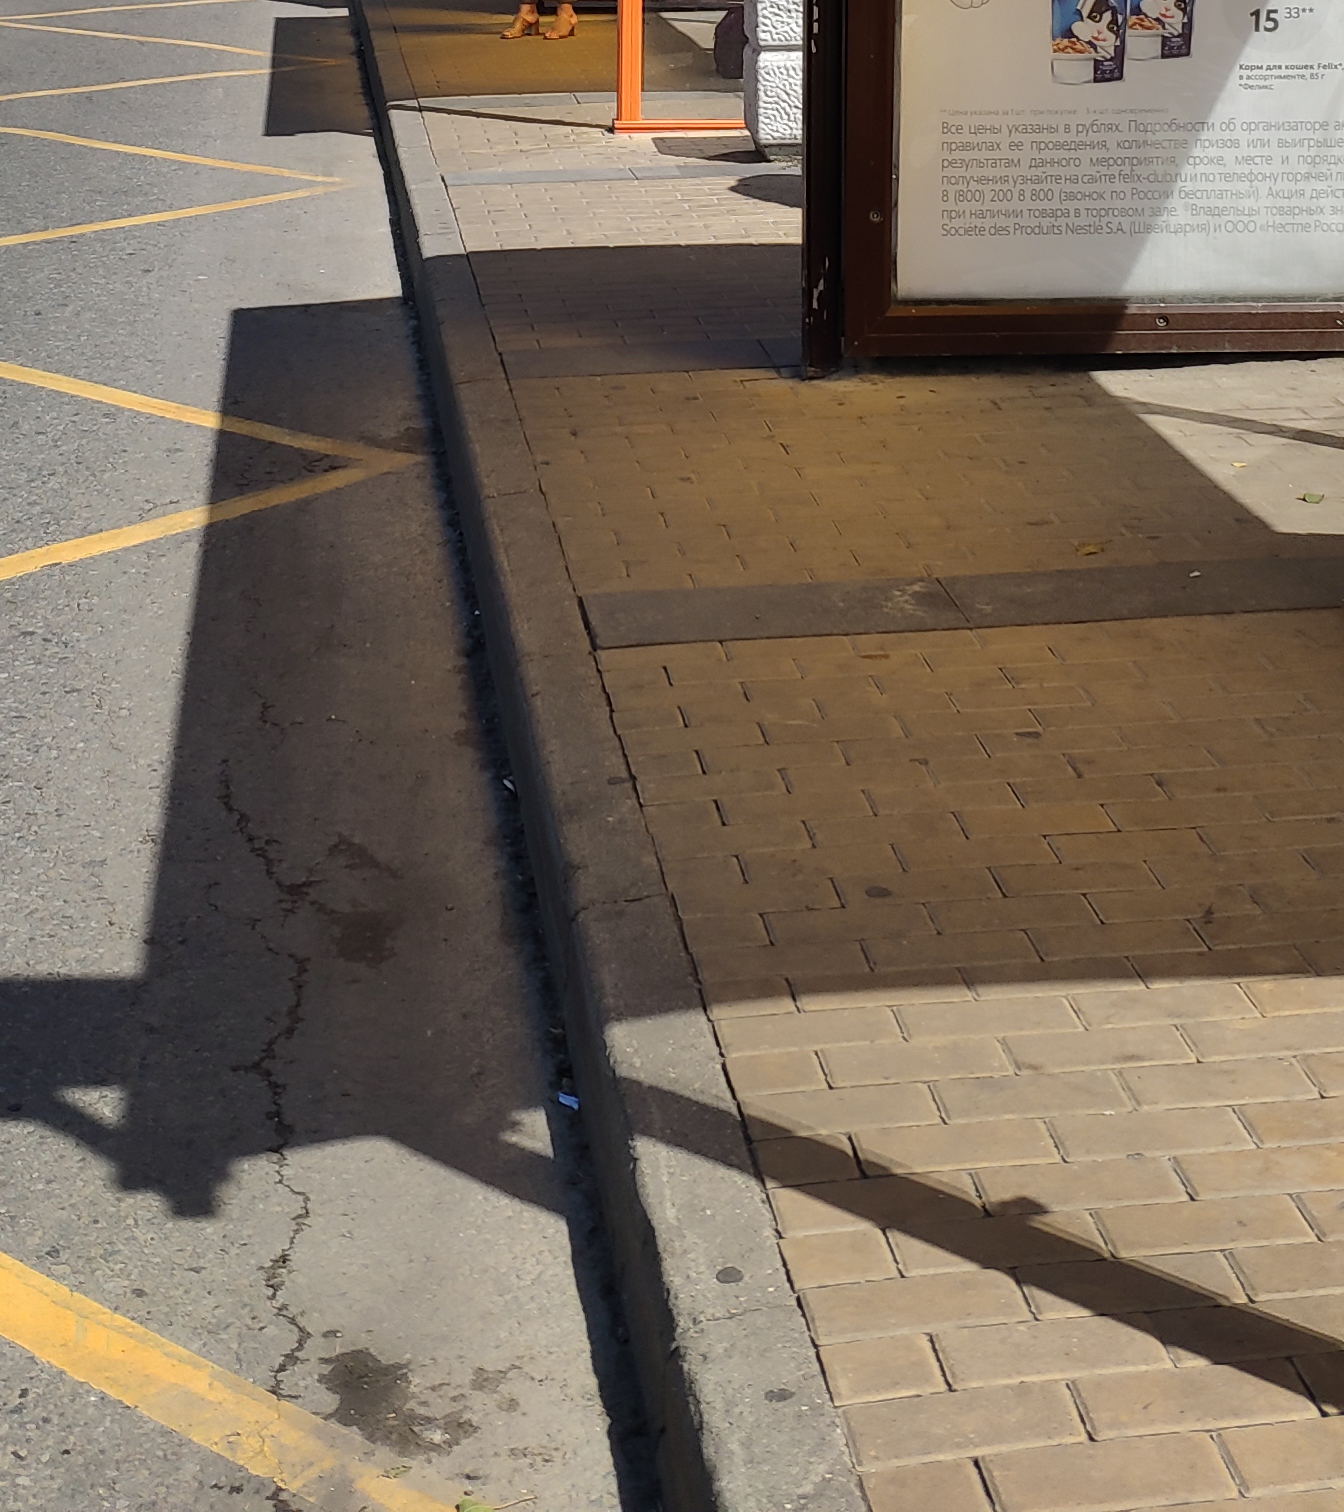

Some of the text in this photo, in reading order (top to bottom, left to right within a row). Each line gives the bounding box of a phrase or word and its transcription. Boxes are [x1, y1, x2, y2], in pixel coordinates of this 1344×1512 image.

[1249, 8, 1279, 32] 15
[1239, 64, 1263, 72] Корм
[1246, 73, 1307, 82] ассортименте,
[941, 122, 963, 134] Все
[969, 124, 1002, 136] цены
[1007, 124, 1059, 137] указаны
[1064, 124, 1071, 133] в
[1076, 119, 1123, 137] рублях.
[1128, 118, 1215, 135] Подробности
[1220, 118, 1236, 132] об
[1240, 120, 1329, 135] организаторе
[941, 141, 1002, 154] правилах
[1009, 141, 1024, 151] ее
[1031, 140, 1110, 154] проведения,
[1116, 138, 1188, 150] количестве
[1195, 137, 1240, 152] призов
[1247, 137, 1270, 149] или
[941, 157, 1020, 172] результатам
[1028, 157, 1081, 170] данного
[1090, 155, 1178, 171] мероприятия,
[1186, 155, 1226, 169] сроке,
[1235, 154, 1273, 165] месте
[1281, 154, 1289, 165] и
[941, 175, 1010, 188] получения
[1013, 171, 1062, 188] узнайте
[1064, 175, 1079, 184] на
[1081, 170, 1116, 184] сайте
[1118, 169, 1187, 184] felix-club.ru
[1189, 172, 1197, 183] и
[1200, 172, 1215, 183] по
[1218, 171, 1280, 187] телефону
[1281, 170, 1333, 185] горячей
[941, 189, 949, 202] 8
[954, 189, 985, 206] (800)
[990, 189, 1013, 202] 200
[1018, 189, 1025, 202] 8
[1030, 188, 1054, 202] 800
[1059, 188, 1106, 205] (звонок
[1111, 190, 1126, 201] по
[1131, 187, 1174, 201] России
[1178, 186, 1260, 202] бесплатный).
[1266, 187, 1305, 201] Акция
[941, 209, 965, 222] при
[969, 209, 1023, 219] наличии
[1026, 208, 1070, 222] товара
[1074, 208, 1081, 218] в
[1085, 207, 1145, 222] торговом
[1148, 205, 1179, 217] зале.
[1264, 205, 1325, 220] товарных
[941, 221, 986, 237] Société
[988, 222, 1011, 236] des
[1013, 222, 1063, 236] Produits
[1129, 220, 1210, 237] (Швейцария)
[1213, 222, 1221, 234] и
[1224, 220, 1256, 234] ООО
[1259, 221, 1311, 233] «Нестле
